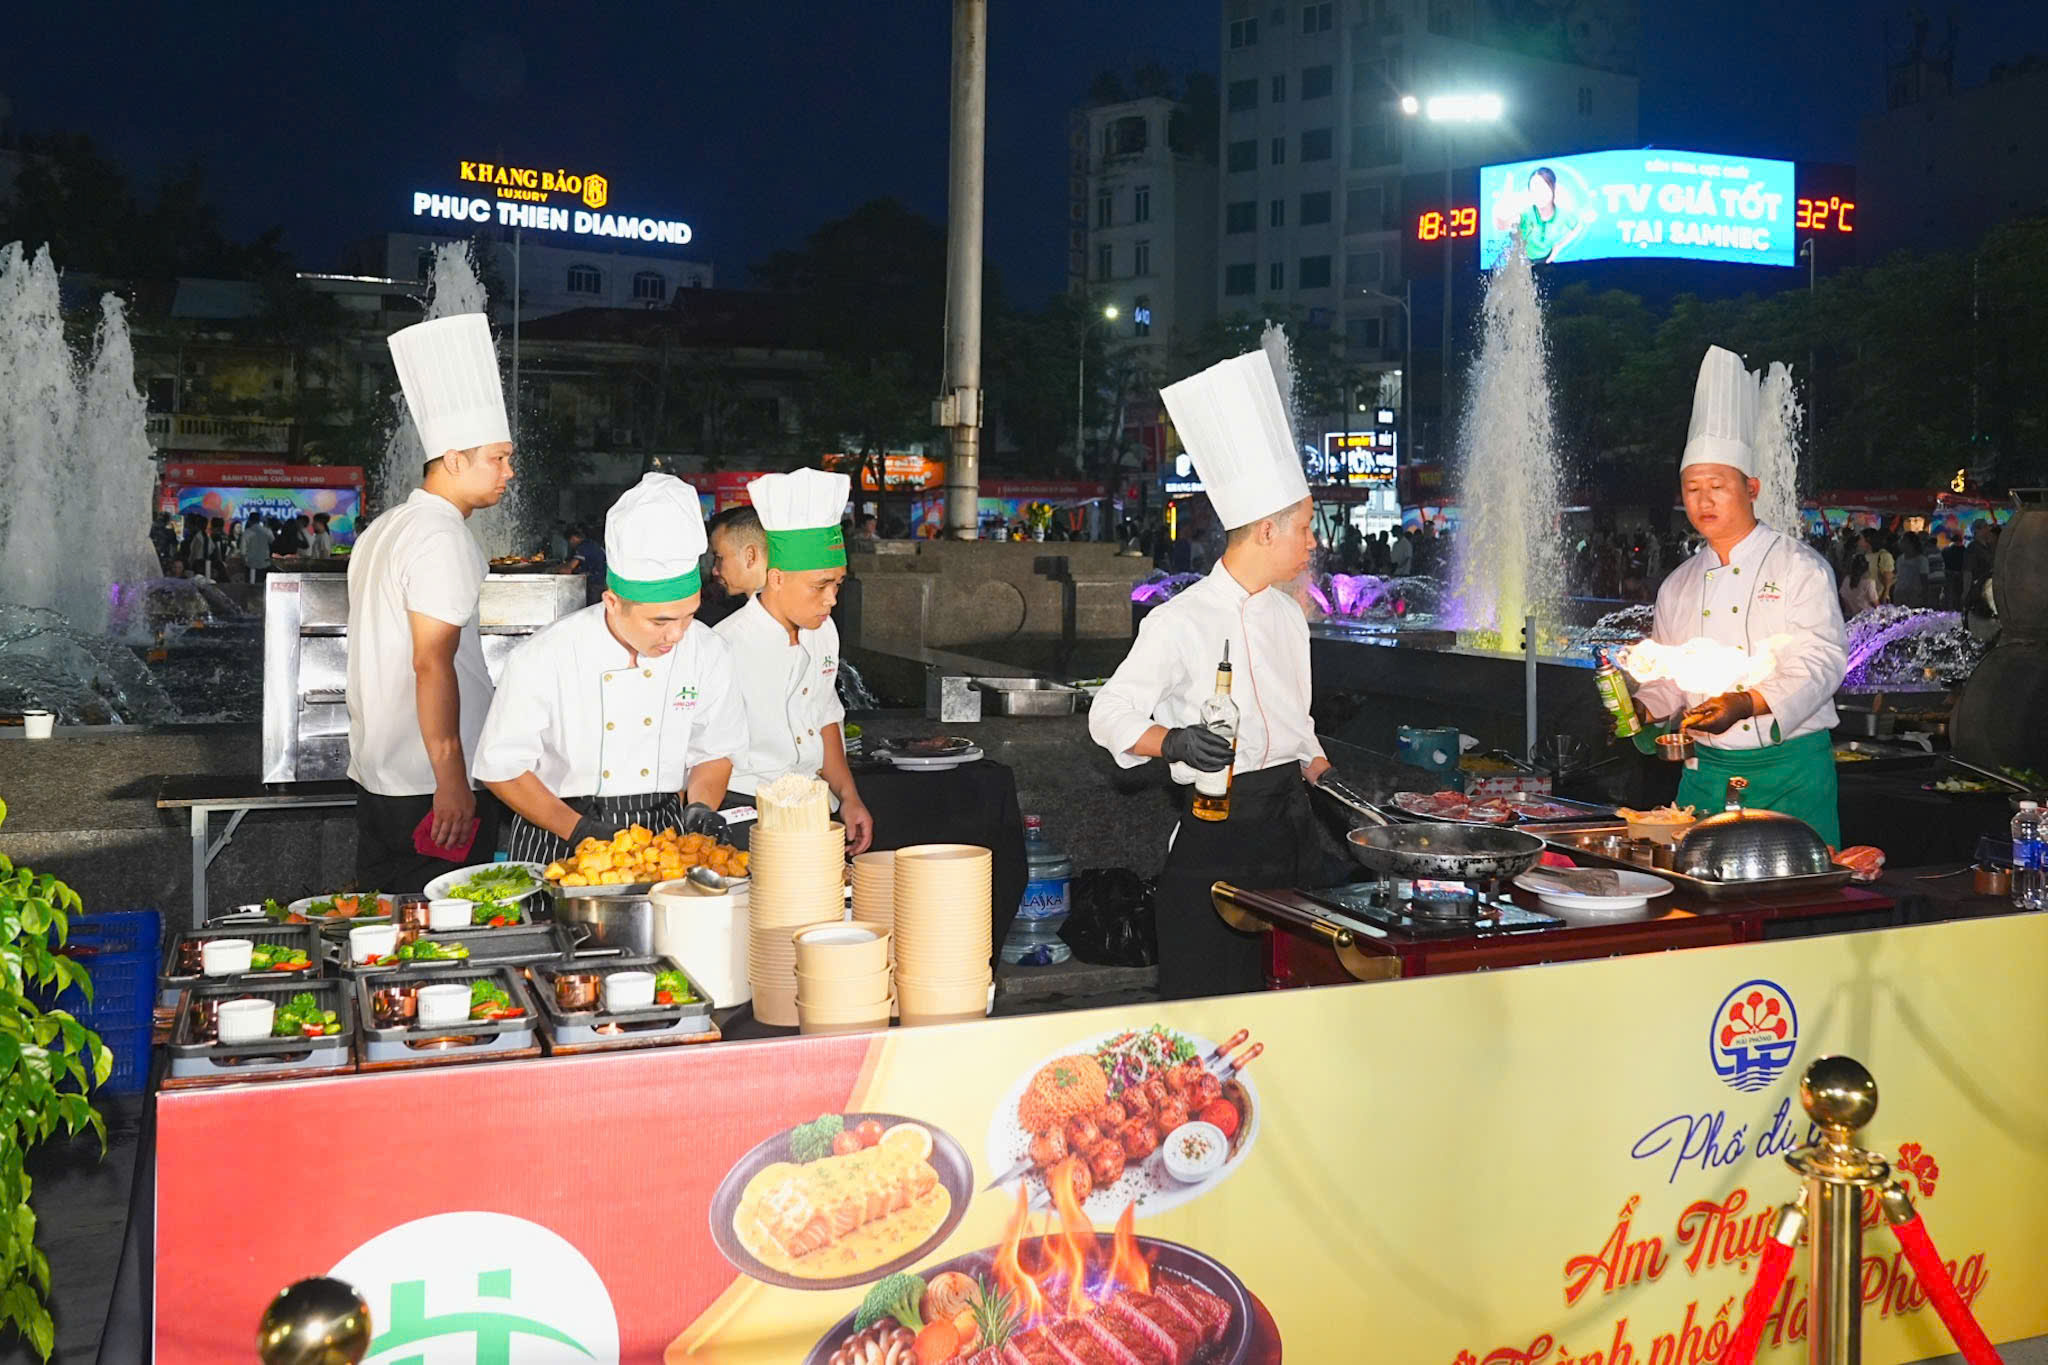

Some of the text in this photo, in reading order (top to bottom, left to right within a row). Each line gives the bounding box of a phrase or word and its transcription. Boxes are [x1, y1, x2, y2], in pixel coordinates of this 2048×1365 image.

[460, 160, 538, 189] KHANG
[541, 169, 582, 194] BẢO
[496, 187, 549, 203] LUXURY
[413, 192, 693, 245] PHUC THIEN DIAMOND
[1603, 179, 1783, 222] TV GIÁ TỐT
[1617, 220, 1663, 249] TẠI
[1632, 1110, 1747, 1183] Phố
[1756, 1097, 1797, 1158] đi
[1564, 1194, 1668, 1305] Ẩm
[1676, 1188, 1790, 1275] Thự
